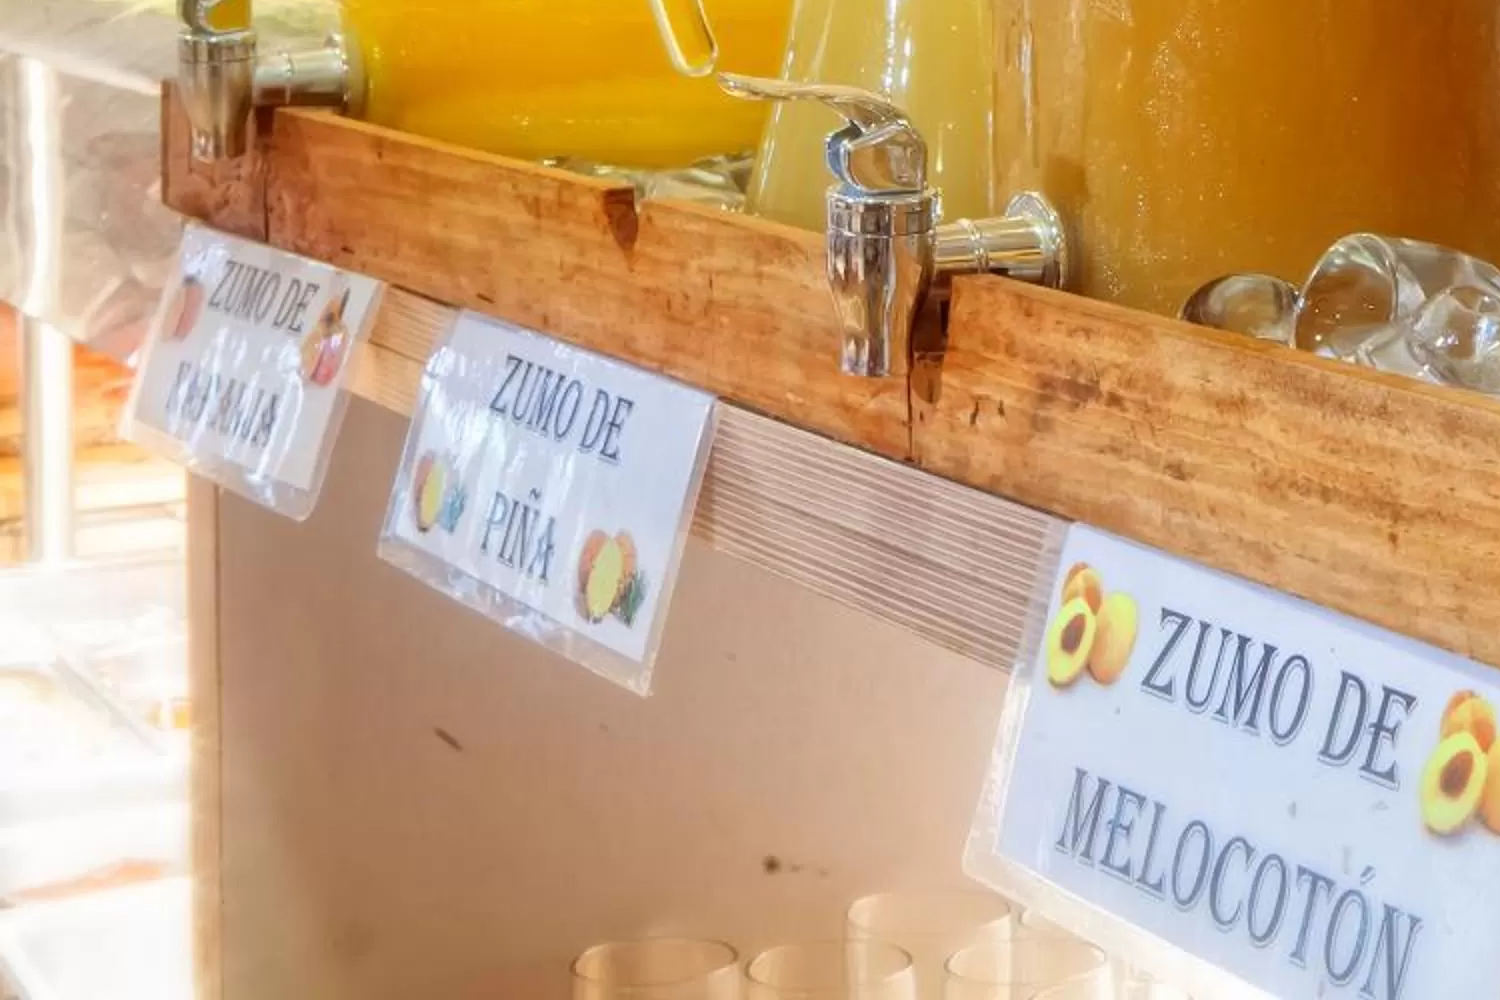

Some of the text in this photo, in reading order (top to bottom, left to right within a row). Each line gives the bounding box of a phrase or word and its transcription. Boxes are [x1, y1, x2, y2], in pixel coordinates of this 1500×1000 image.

[208, 260, 320, 332] ZUMO DE
[489, 355, 634, 461] ZUMO DE
[480, 488, 557, 583] PIÑA
[1141, 607, 1417, 788] ZUMO DE
[1055, 767, 1423, 1000] MELOCOTÓN
